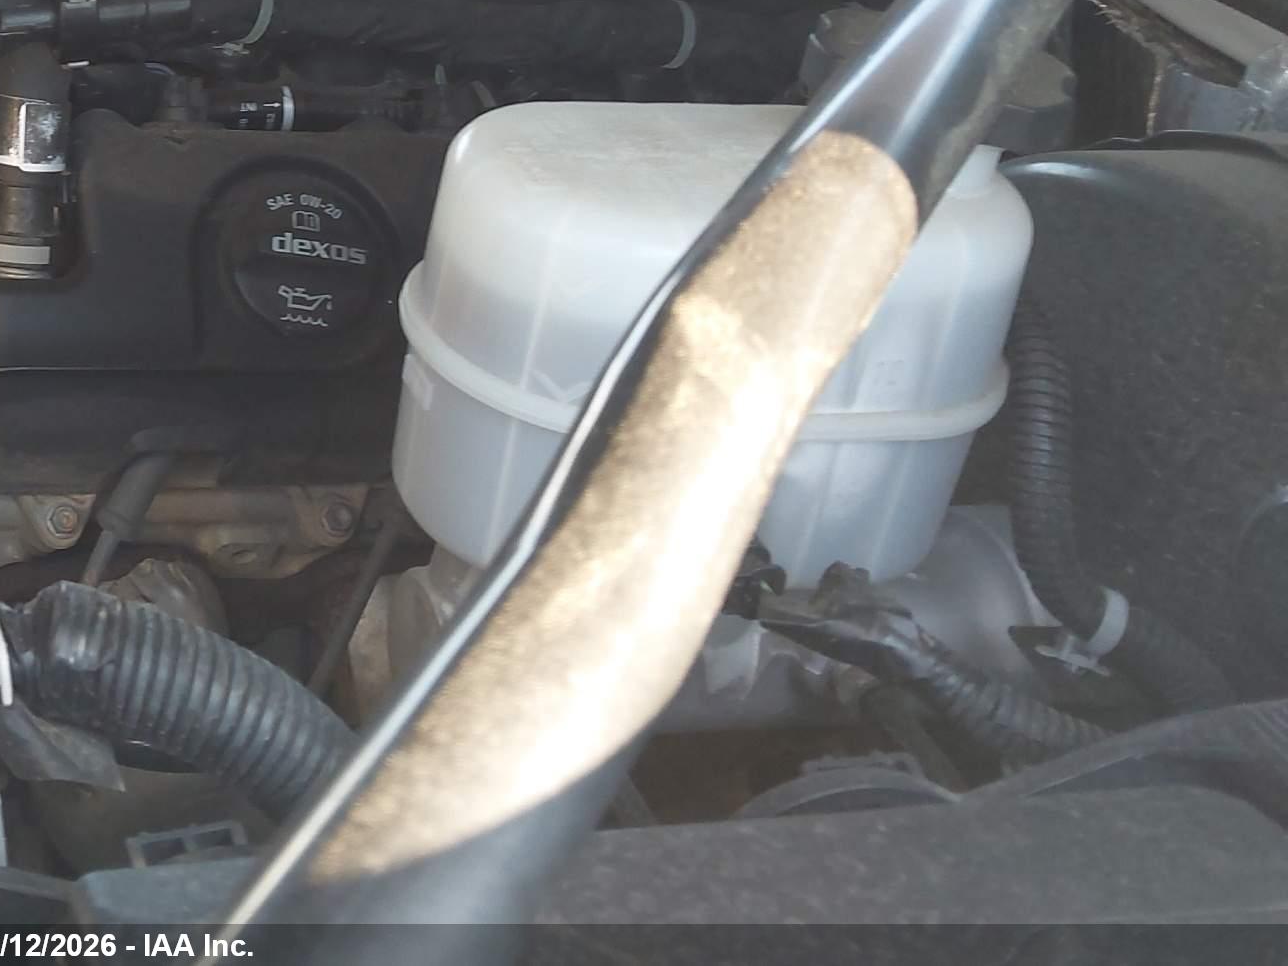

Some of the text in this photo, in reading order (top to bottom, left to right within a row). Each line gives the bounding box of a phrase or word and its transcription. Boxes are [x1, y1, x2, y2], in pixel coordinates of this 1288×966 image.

[265, 192, 345, 220] SAE 0W-20
[271, 232, 369, 266] dexos
